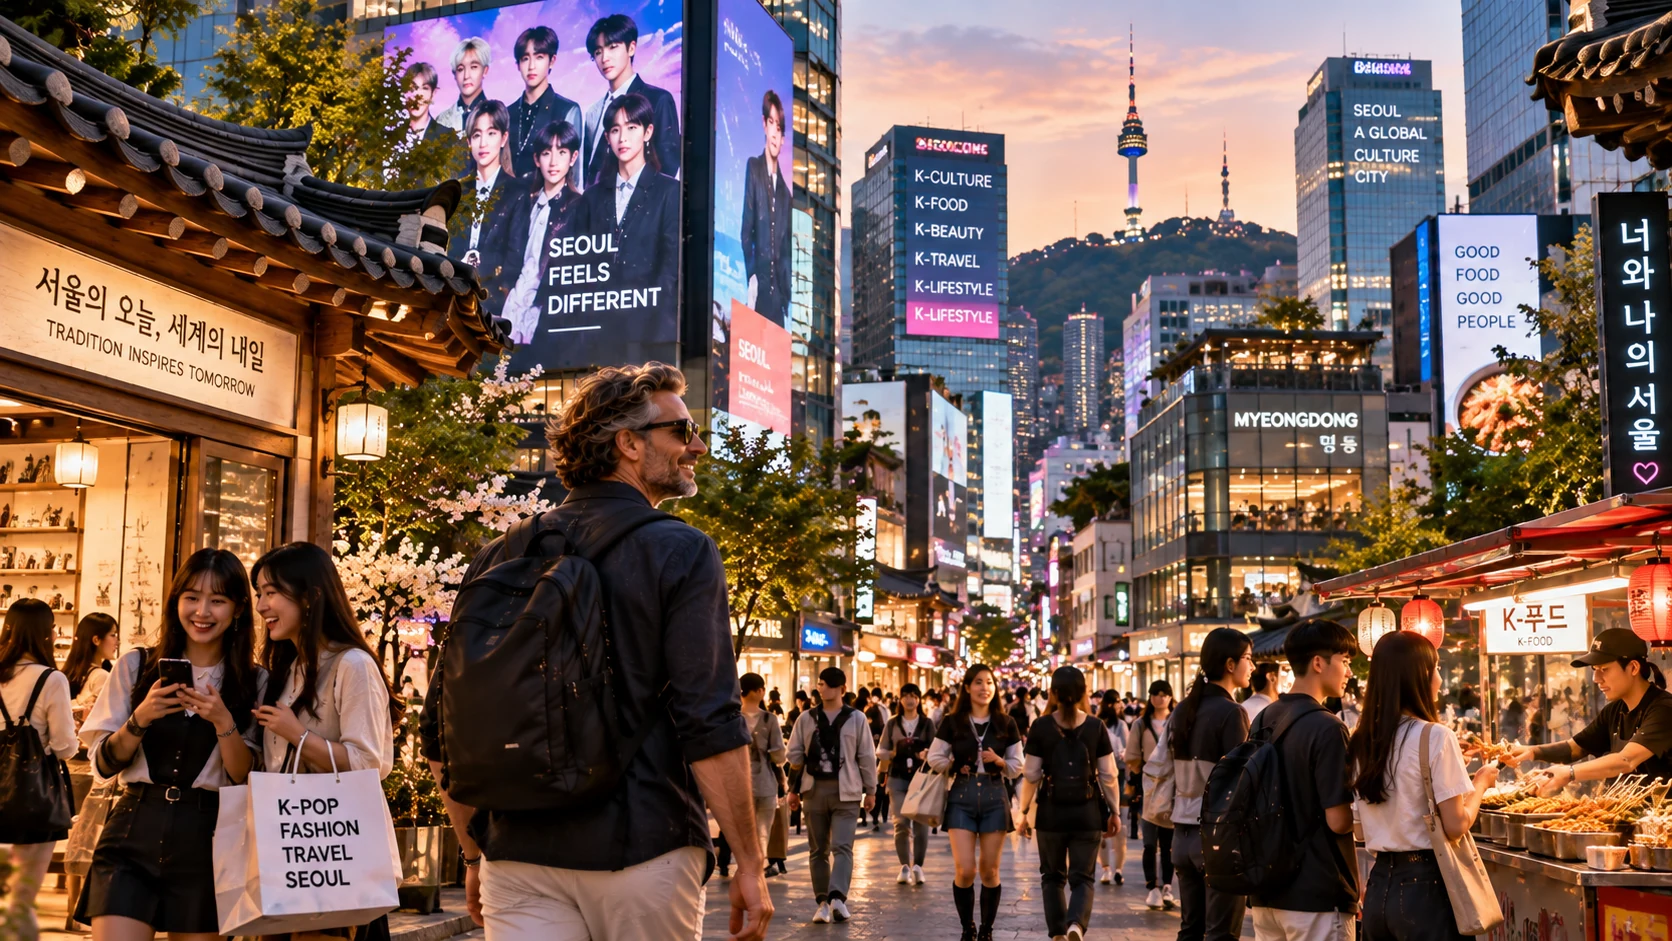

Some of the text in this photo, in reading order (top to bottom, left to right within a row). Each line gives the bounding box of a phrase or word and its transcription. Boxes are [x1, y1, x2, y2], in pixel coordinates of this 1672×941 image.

[1354, 103, 1402, 118] SEOUL
[1353, 125, 1427, 140] A GLOBAL
[1353, 148, 1420, 164] CULTURE
[914, 169, 993, 189] K-CULTURE
[1354, 168, 1389, 184] CITY
[914, 195, 969, 212] K-FOOD
[914, 223, 984, 240] K-BEAUTY
[548, 232, 620, 259] SEOUL
[1454, 245, 1500, 259] GOOD
[914, 252, 981, 268] K-TRAVEL
[548, 262, 611, 286] FEELS
[1455, 267, 1500, 282] FOOD
[914, 280, 994, 297] K-LIFESTYLE
[548, 286, 663, 315] DIFFERENT
[1456, 291, 1503, 305] GOOD
[35, 266, 264, 374] 서울의 오늘, 세계의 내일
[914, 306, 994, 324] K-LIFESTYLE
[1457, 315, 1517, 329] PEOPLE
[1620, 218, 1661, 452] 너와 나의 서울
[46, 318, 256, 398] TRADITION INSPIRES TOMORROW
[1234, 411, 1359, 429] MYEONGDONG
[1502, 604, 1568, 633] K-푸드
[1517, 636, 1554, 647] K-FOOD
[277, 797, 339, 816] K-POP
[280, 819, 360, 840] FASHION
[281, 844, 354, 864] TRAVEL
[285, 869, 351, 889] SEOUL
